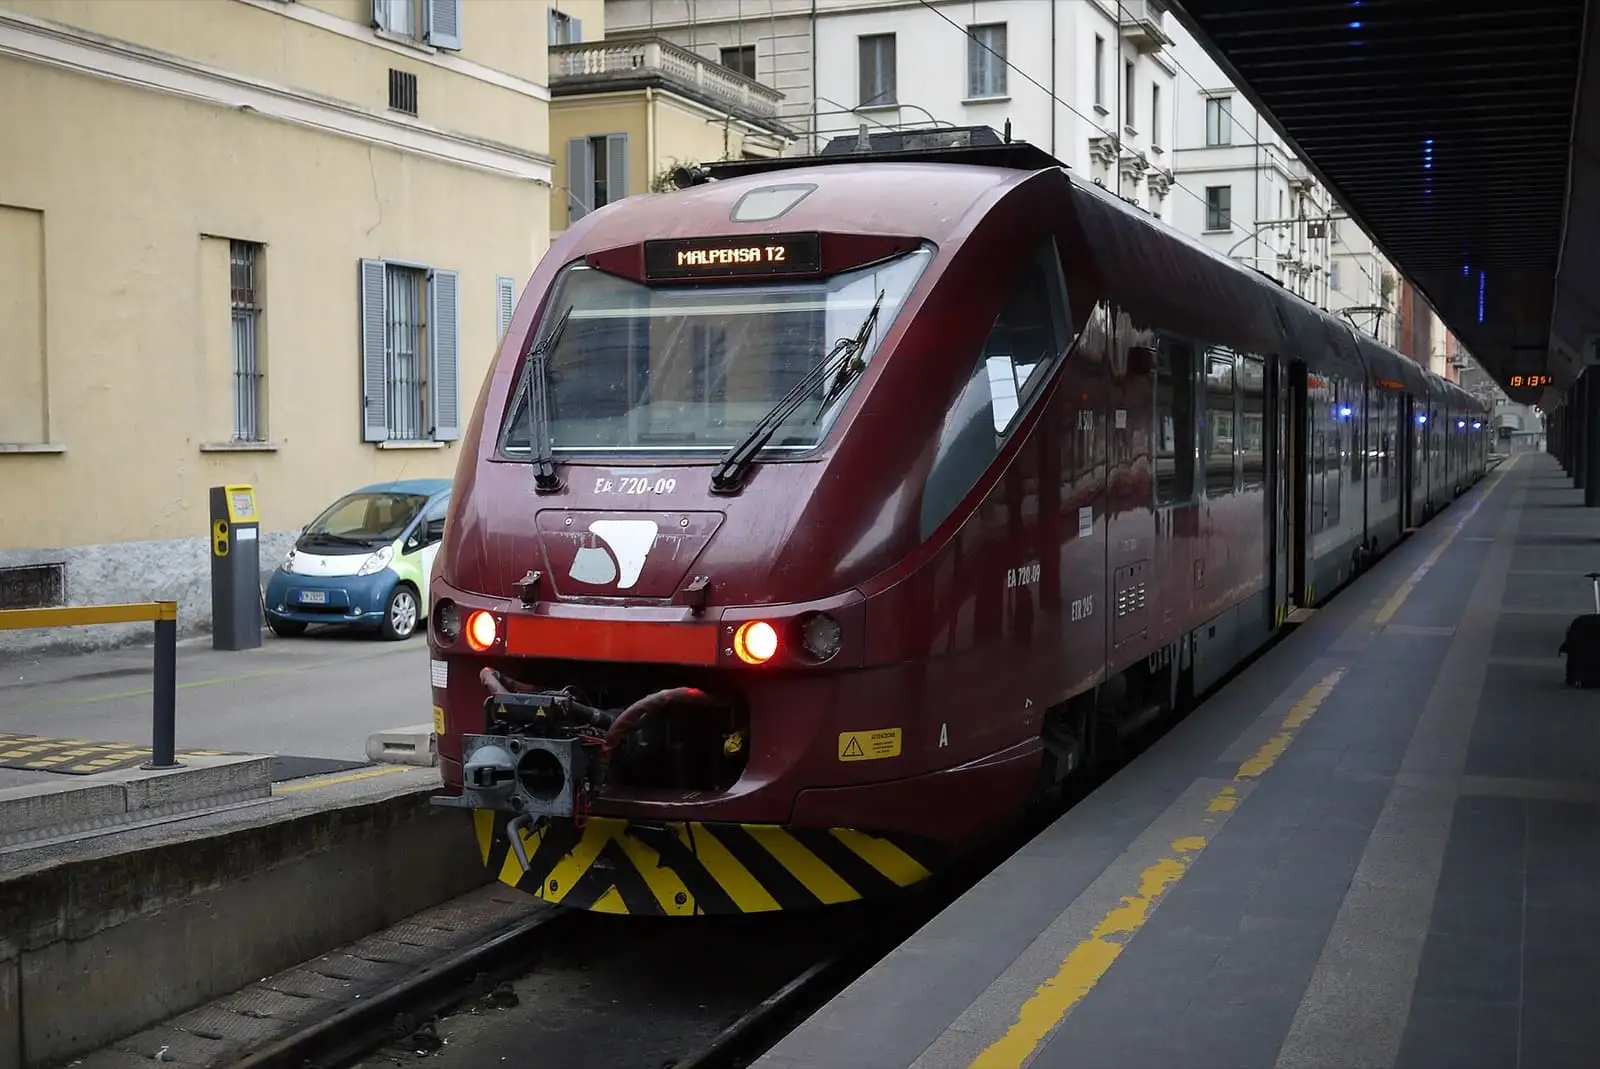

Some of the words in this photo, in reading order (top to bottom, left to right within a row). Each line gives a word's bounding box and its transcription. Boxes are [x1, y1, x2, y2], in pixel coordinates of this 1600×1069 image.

[677, 248, 761, 266] MALPENSA
[765, 246, 786, 261] T2
[1510, 375, 1539, 387] 19:13
[593, 477, 612, 494] EA
[1007, 569, 1017, 588] EA
[1071, 599, 1082, 622] ETR
[938, 723, 948, 748] A
